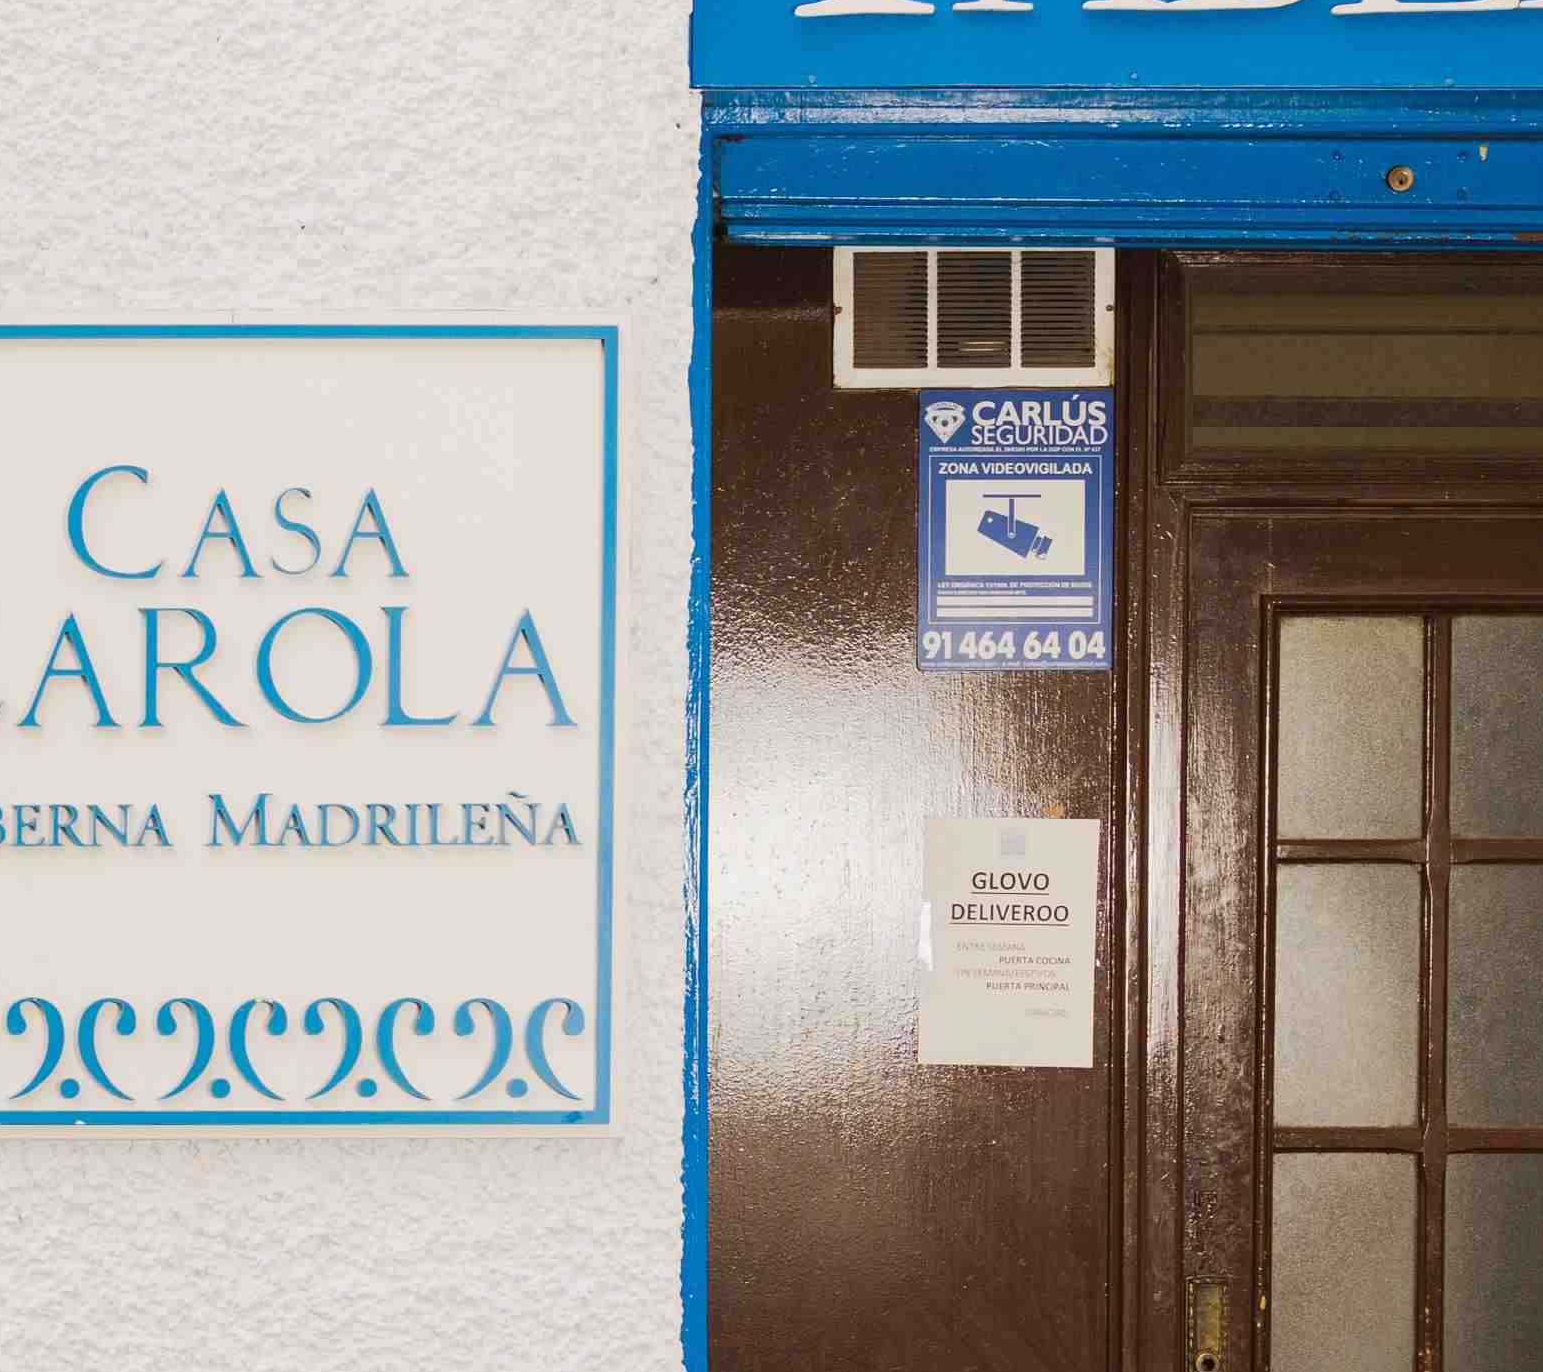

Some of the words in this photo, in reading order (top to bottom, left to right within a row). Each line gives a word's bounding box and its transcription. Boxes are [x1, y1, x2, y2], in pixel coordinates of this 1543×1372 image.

[972, 394, 1106, 426] CARLÚS
[971, 426, 1108, 445] SEGURIDAD
[939, 463, 979, 474] ZONA
[981, 462, 1093, 474] VIDEOVIGILADA
[67, 464, 411, 581] CASA
[923, 631, 952, 659] 91
[959, 631, 1015, 659] 464
[1023, 631, 1060, 659] 64
[1069, 631, 1105, 659] 04
[206, 791, 584, 848] MADRILEÑA
[972, 871, 1049, 890] GLOVO
[951, 904, 1069, 922] DELIVEROO
[999, 956, 1033, 964] PUERTA
[986, 982, 1021, 990] PUERTA
